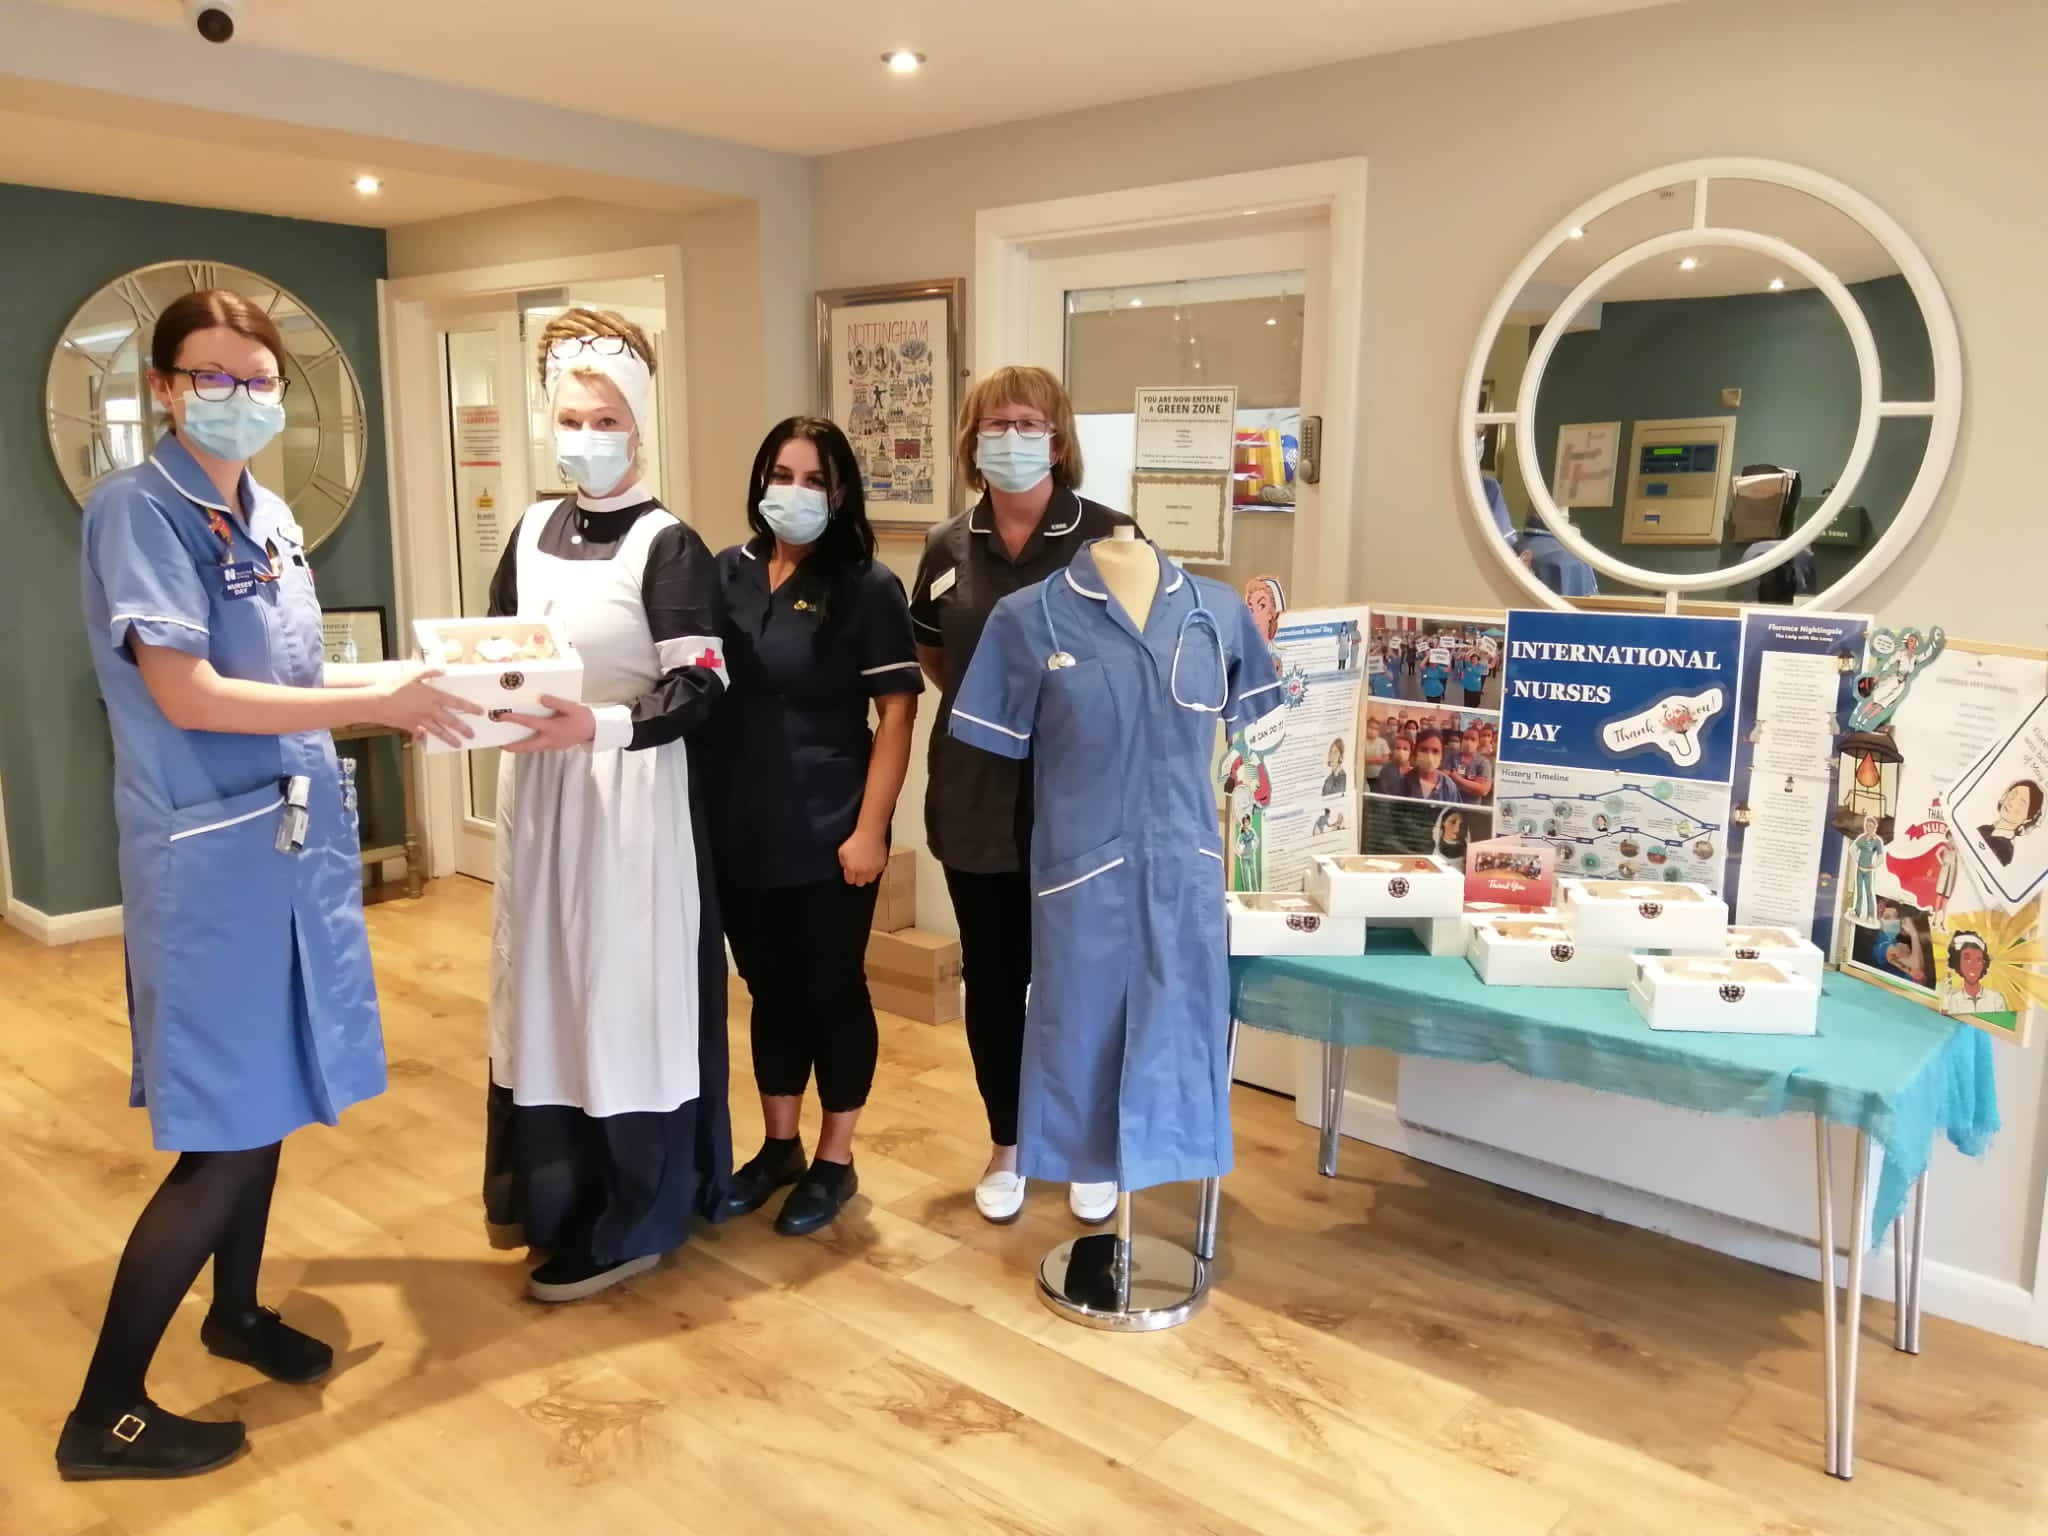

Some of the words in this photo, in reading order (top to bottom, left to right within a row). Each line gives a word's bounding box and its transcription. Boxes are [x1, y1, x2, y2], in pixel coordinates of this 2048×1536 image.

[847, 320, 929, 347] NOTTINGHAM
[1192, 395, 1229, 403] ENTERING
[1157, 404, 1190, 414] GREEN
[1192, 404, 1221, 414] ZONE
[1768, 623, 1799, 632] Florence
[1800, 625, 1843, 636] Nightingale
[1511, 640, 1722, 670] INTERNATIONAL
[1513, 680, 1612, 704] NURSES
[1511, 721, 1562, 742] DAY
[1614, 719, 1655, 743] Thank
[1502, 768, 1531, 780] History
[1534, 771, 1569, 782] Timeline
[1488, 879, 1510, 889] Thank
[1510, 879, 1527, 892] You
